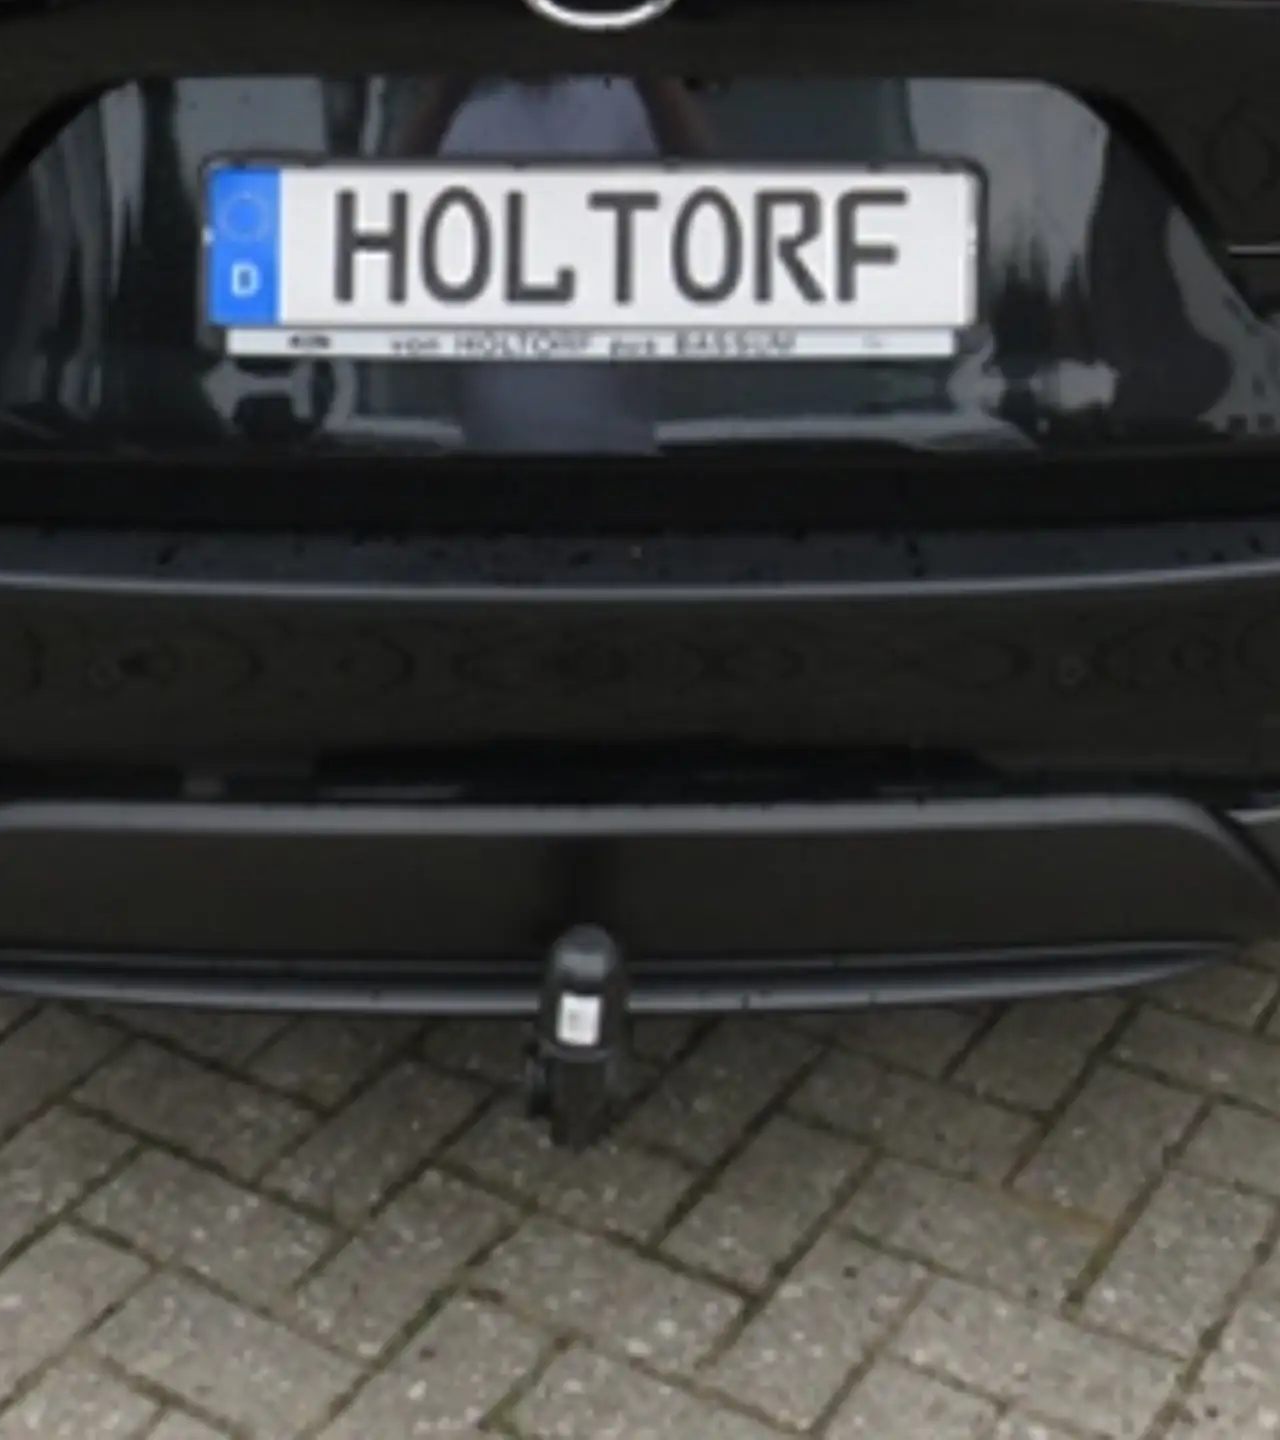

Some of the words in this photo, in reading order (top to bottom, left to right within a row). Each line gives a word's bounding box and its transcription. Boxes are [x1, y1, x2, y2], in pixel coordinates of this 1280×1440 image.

[231, 263, 260, 299] D
[333, 186, 910, 304] HOLTORF
[454, 331, 592, 358] HOLTORF
[675, 330, 798, 358] BASSUM
